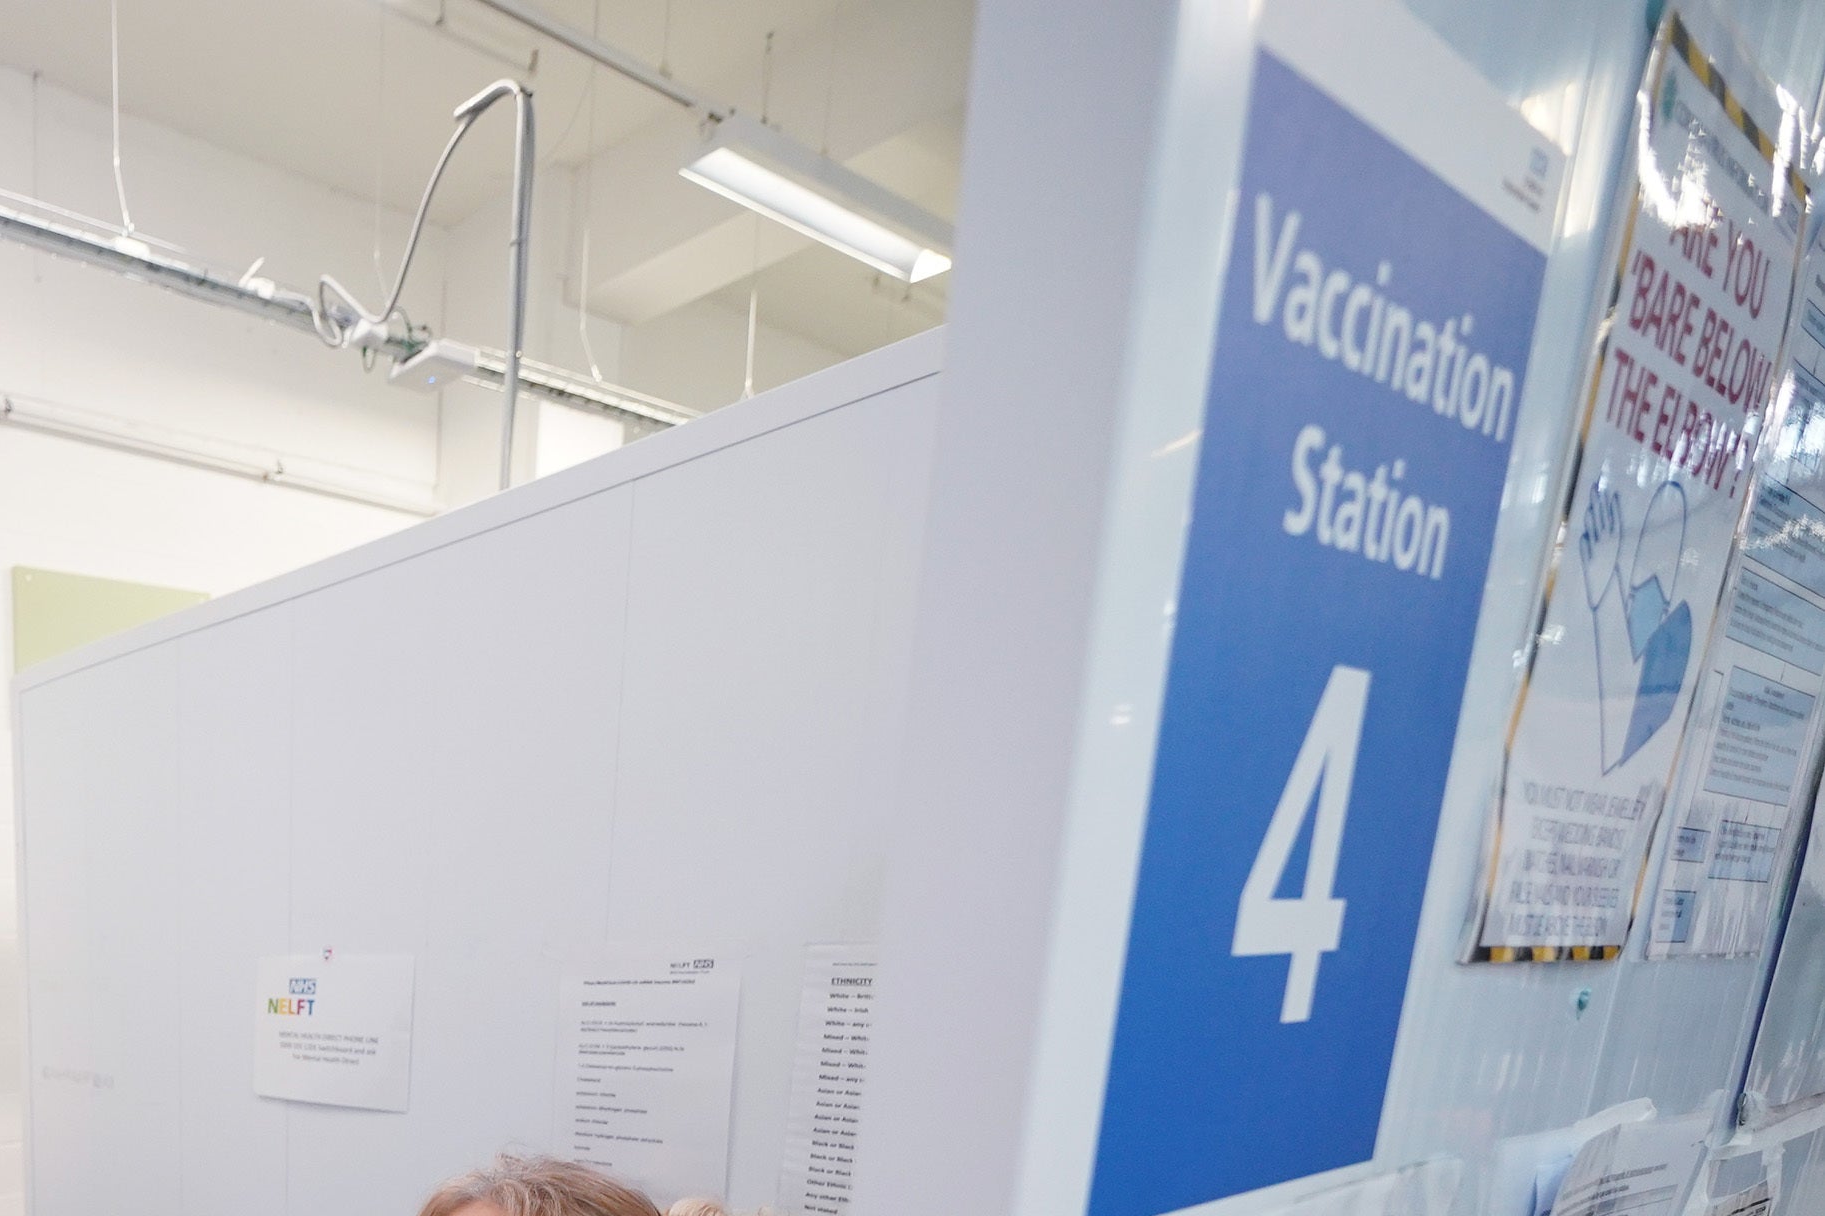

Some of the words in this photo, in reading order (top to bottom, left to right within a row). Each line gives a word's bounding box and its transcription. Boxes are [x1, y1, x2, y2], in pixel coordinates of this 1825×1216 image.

[1253, 192, 1514, 443] Vaccination
[1723, 219, 1770, 320] YOU
[1605, 348, 1657, 444] THE
[1282, 423, 1450, 581] Station
[1231, 664, 1371, 1023] 4
[268, 998, 315, 1016] NELFT
[290, 978, 316, 995] NHS
[831, 977, 873, 986] ETHNICITY
